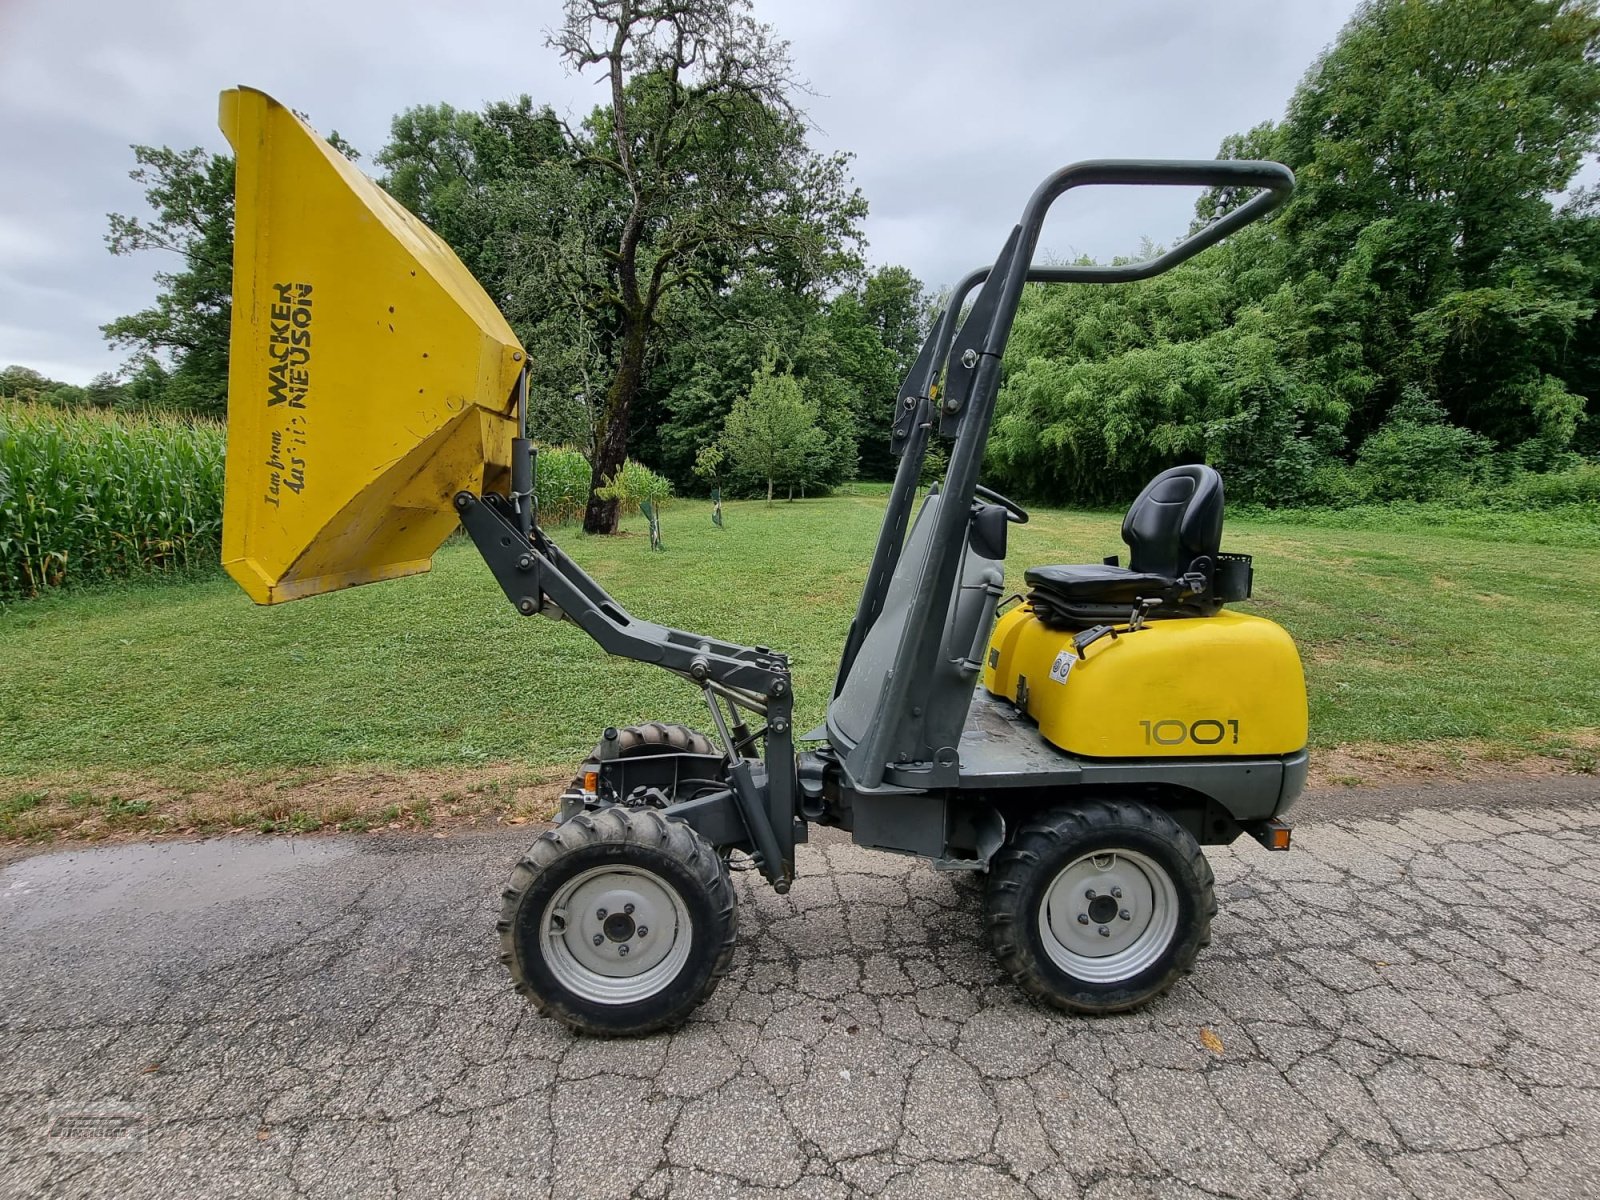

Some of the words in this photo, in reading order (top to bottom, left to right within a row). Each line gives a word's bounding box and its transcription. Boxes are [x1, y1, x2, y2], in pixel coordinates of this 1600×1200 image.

[268, 283, 292, 407] WACKER
[288, 283, 313, 409] NEUSON
[265, 430, 285, 470] from
[269, 471, 281, 495] am
[264, 494, 280, 508] I
[1139, 720, 1239, 746] 1001
